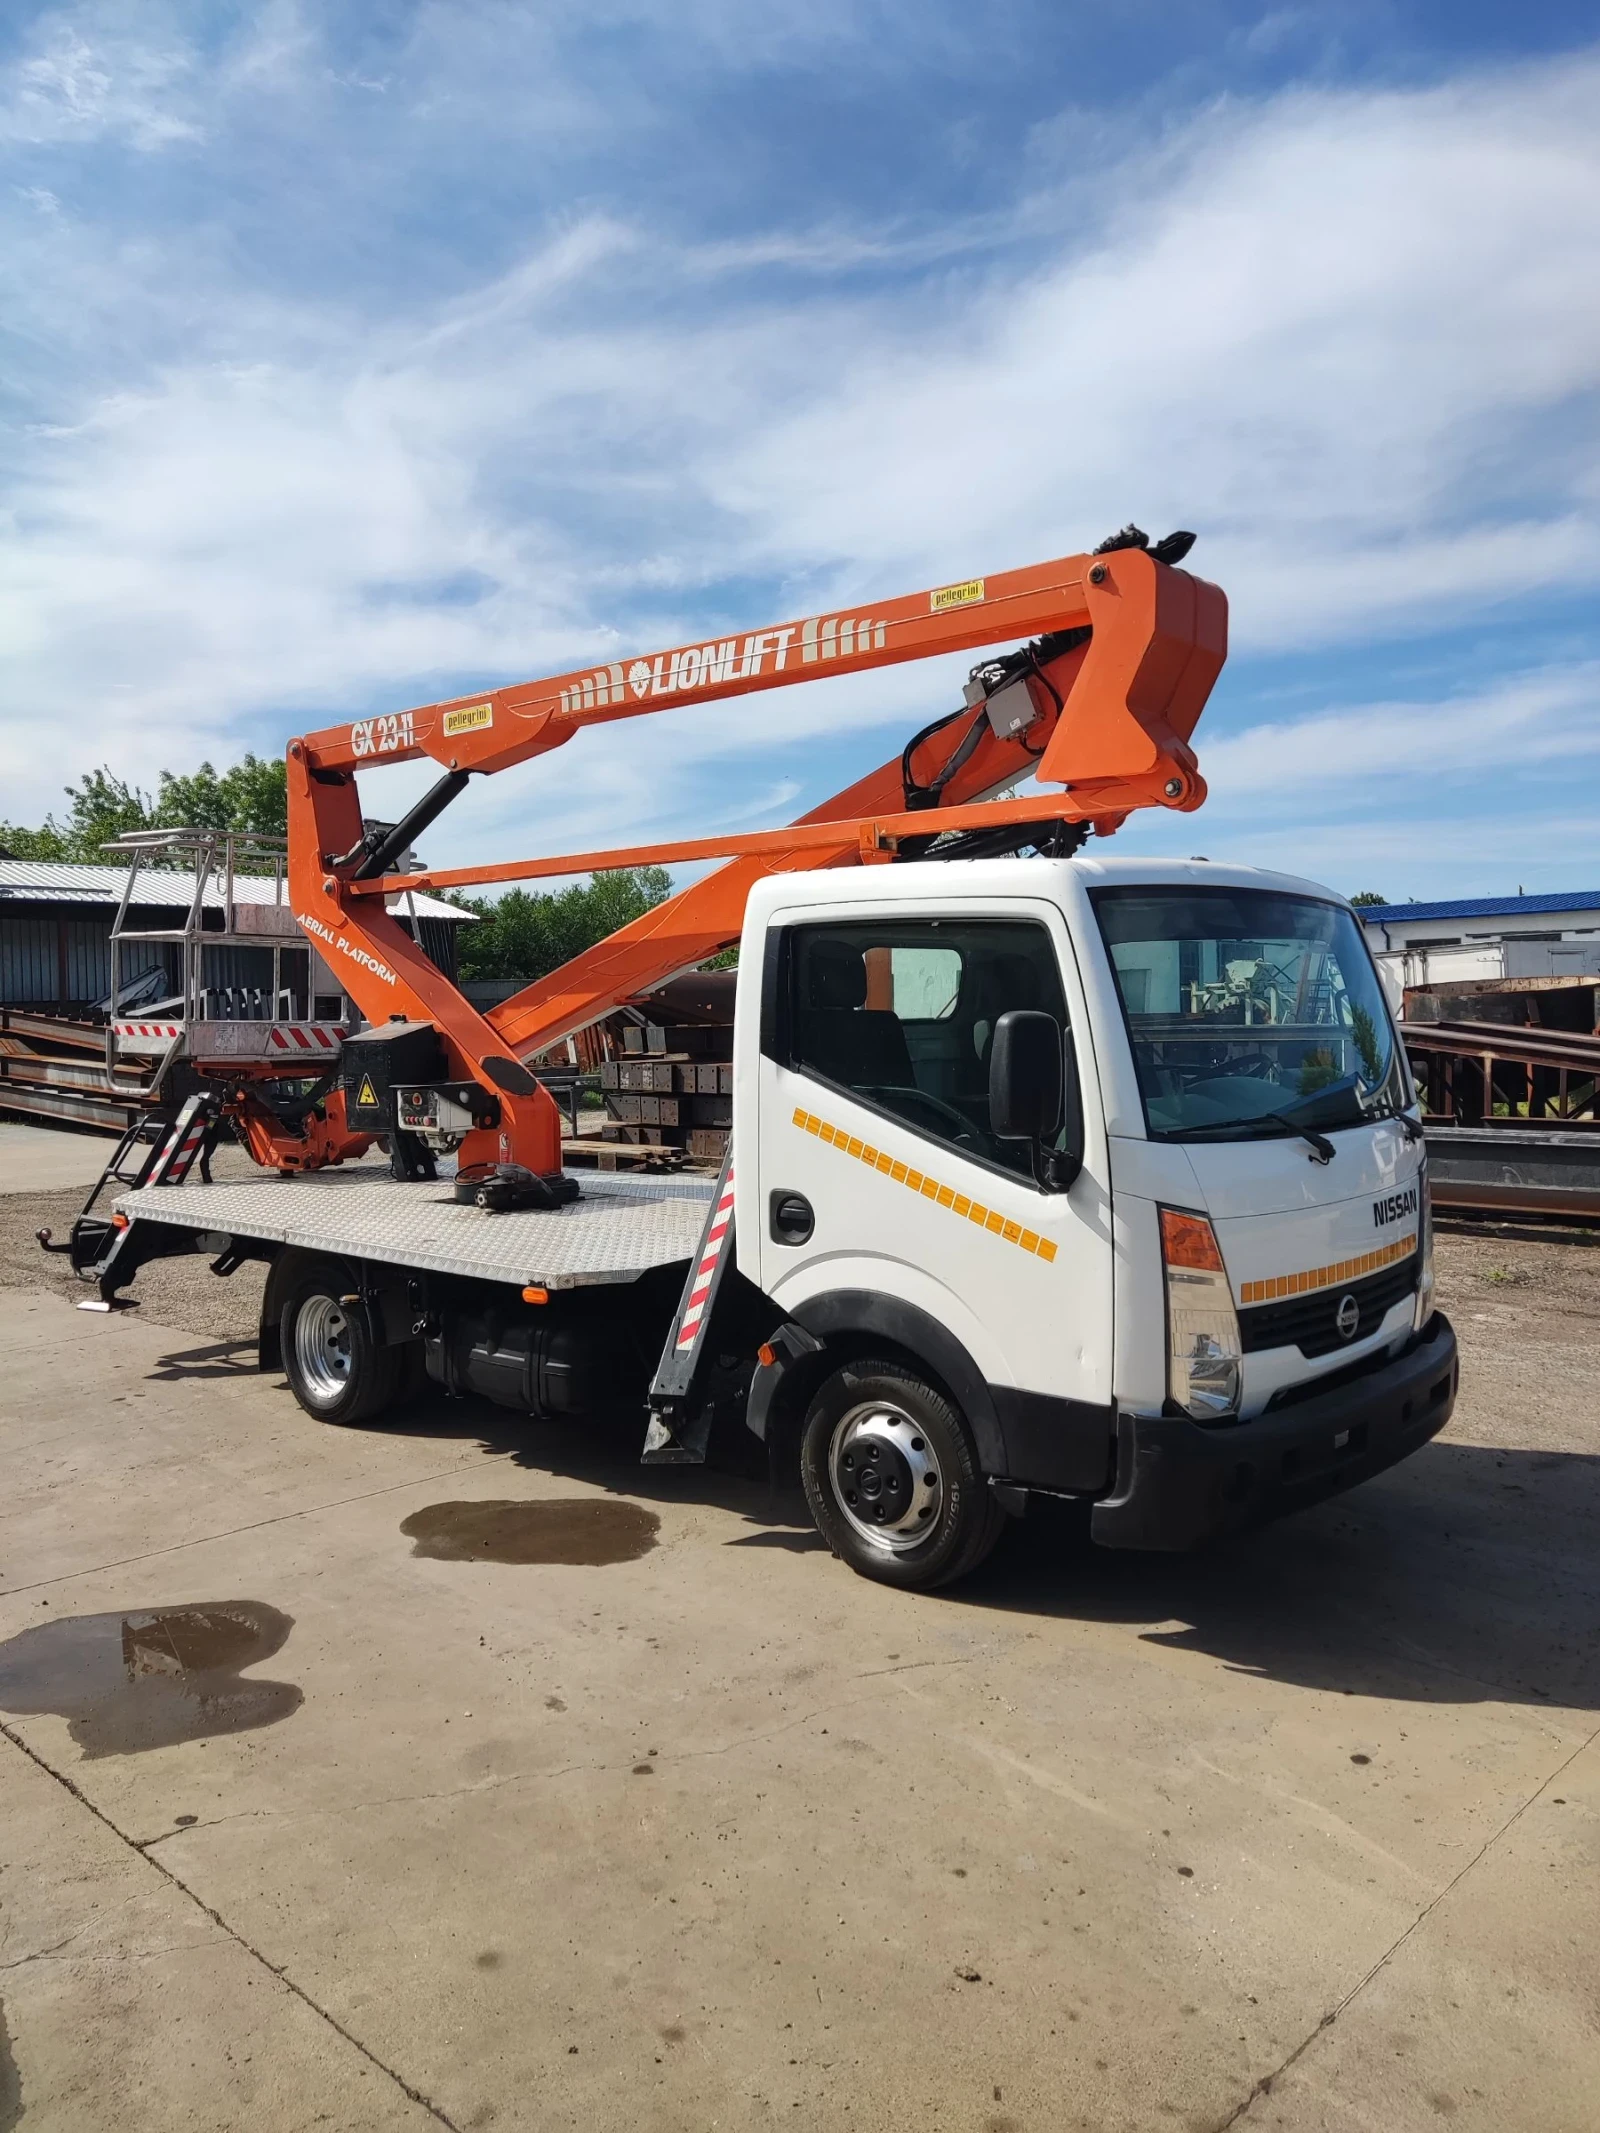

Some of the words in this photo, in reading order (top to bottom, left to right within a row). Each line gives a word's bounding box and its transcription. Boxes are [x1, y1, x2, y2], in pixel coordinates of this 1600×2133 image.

[936, 583, 979, 606] pellegrini
[651, 627, 796, 696] LIONLIFT
[351, 720, 377, 757] GX
[378, 712, 414, 752] 23-11
[448, 707, 487, 730] pellegrini
[296, 912, 335, 945] AERIAL
[335, 936, 397, 987] PLATFORM
[1372, 1188, 1418, 1228] NISSAN
